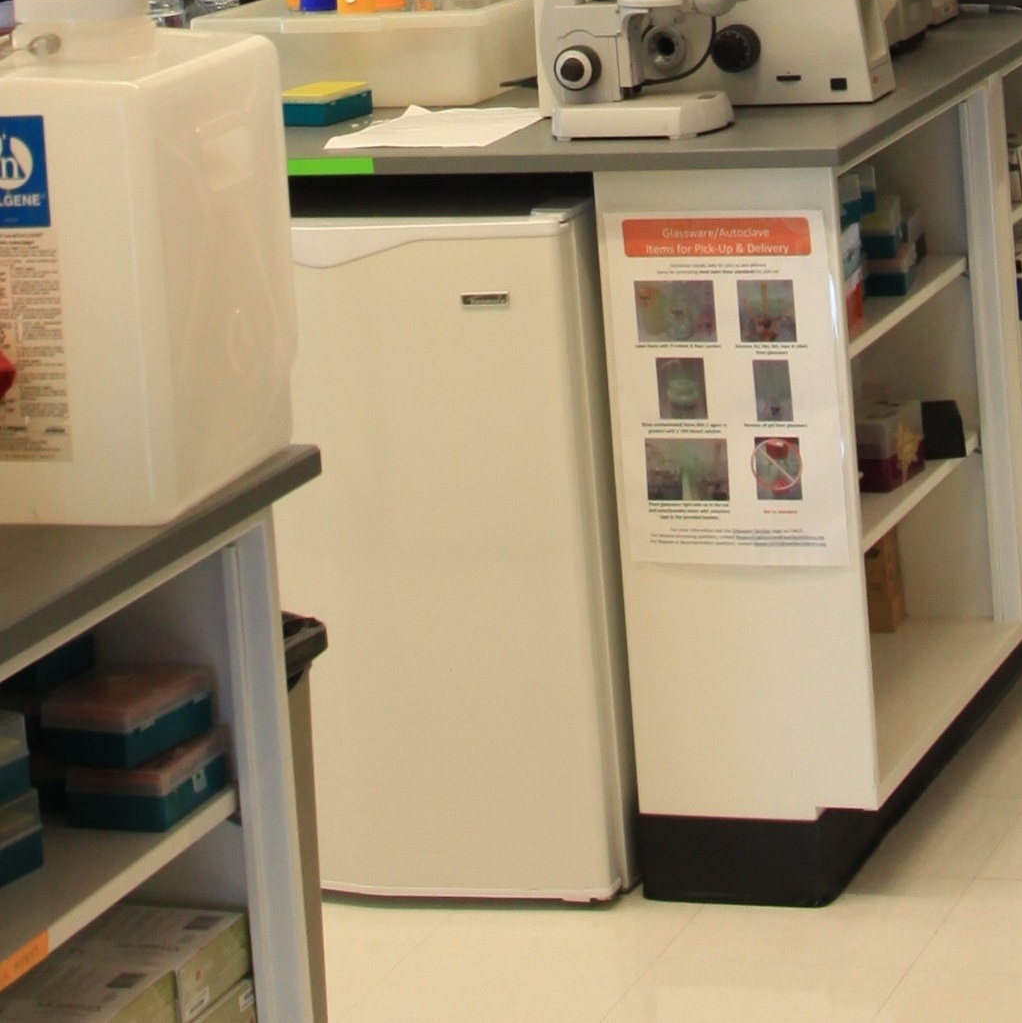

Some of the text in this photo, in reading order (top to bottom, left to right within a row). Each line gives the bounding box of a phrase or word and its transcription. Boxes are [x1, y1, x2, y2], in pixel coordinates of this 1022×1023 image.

[662, 227, 770, 239] Glassware/Autoclave
[645, 242, 789, 255] Items for Pick-Up & Delivery
